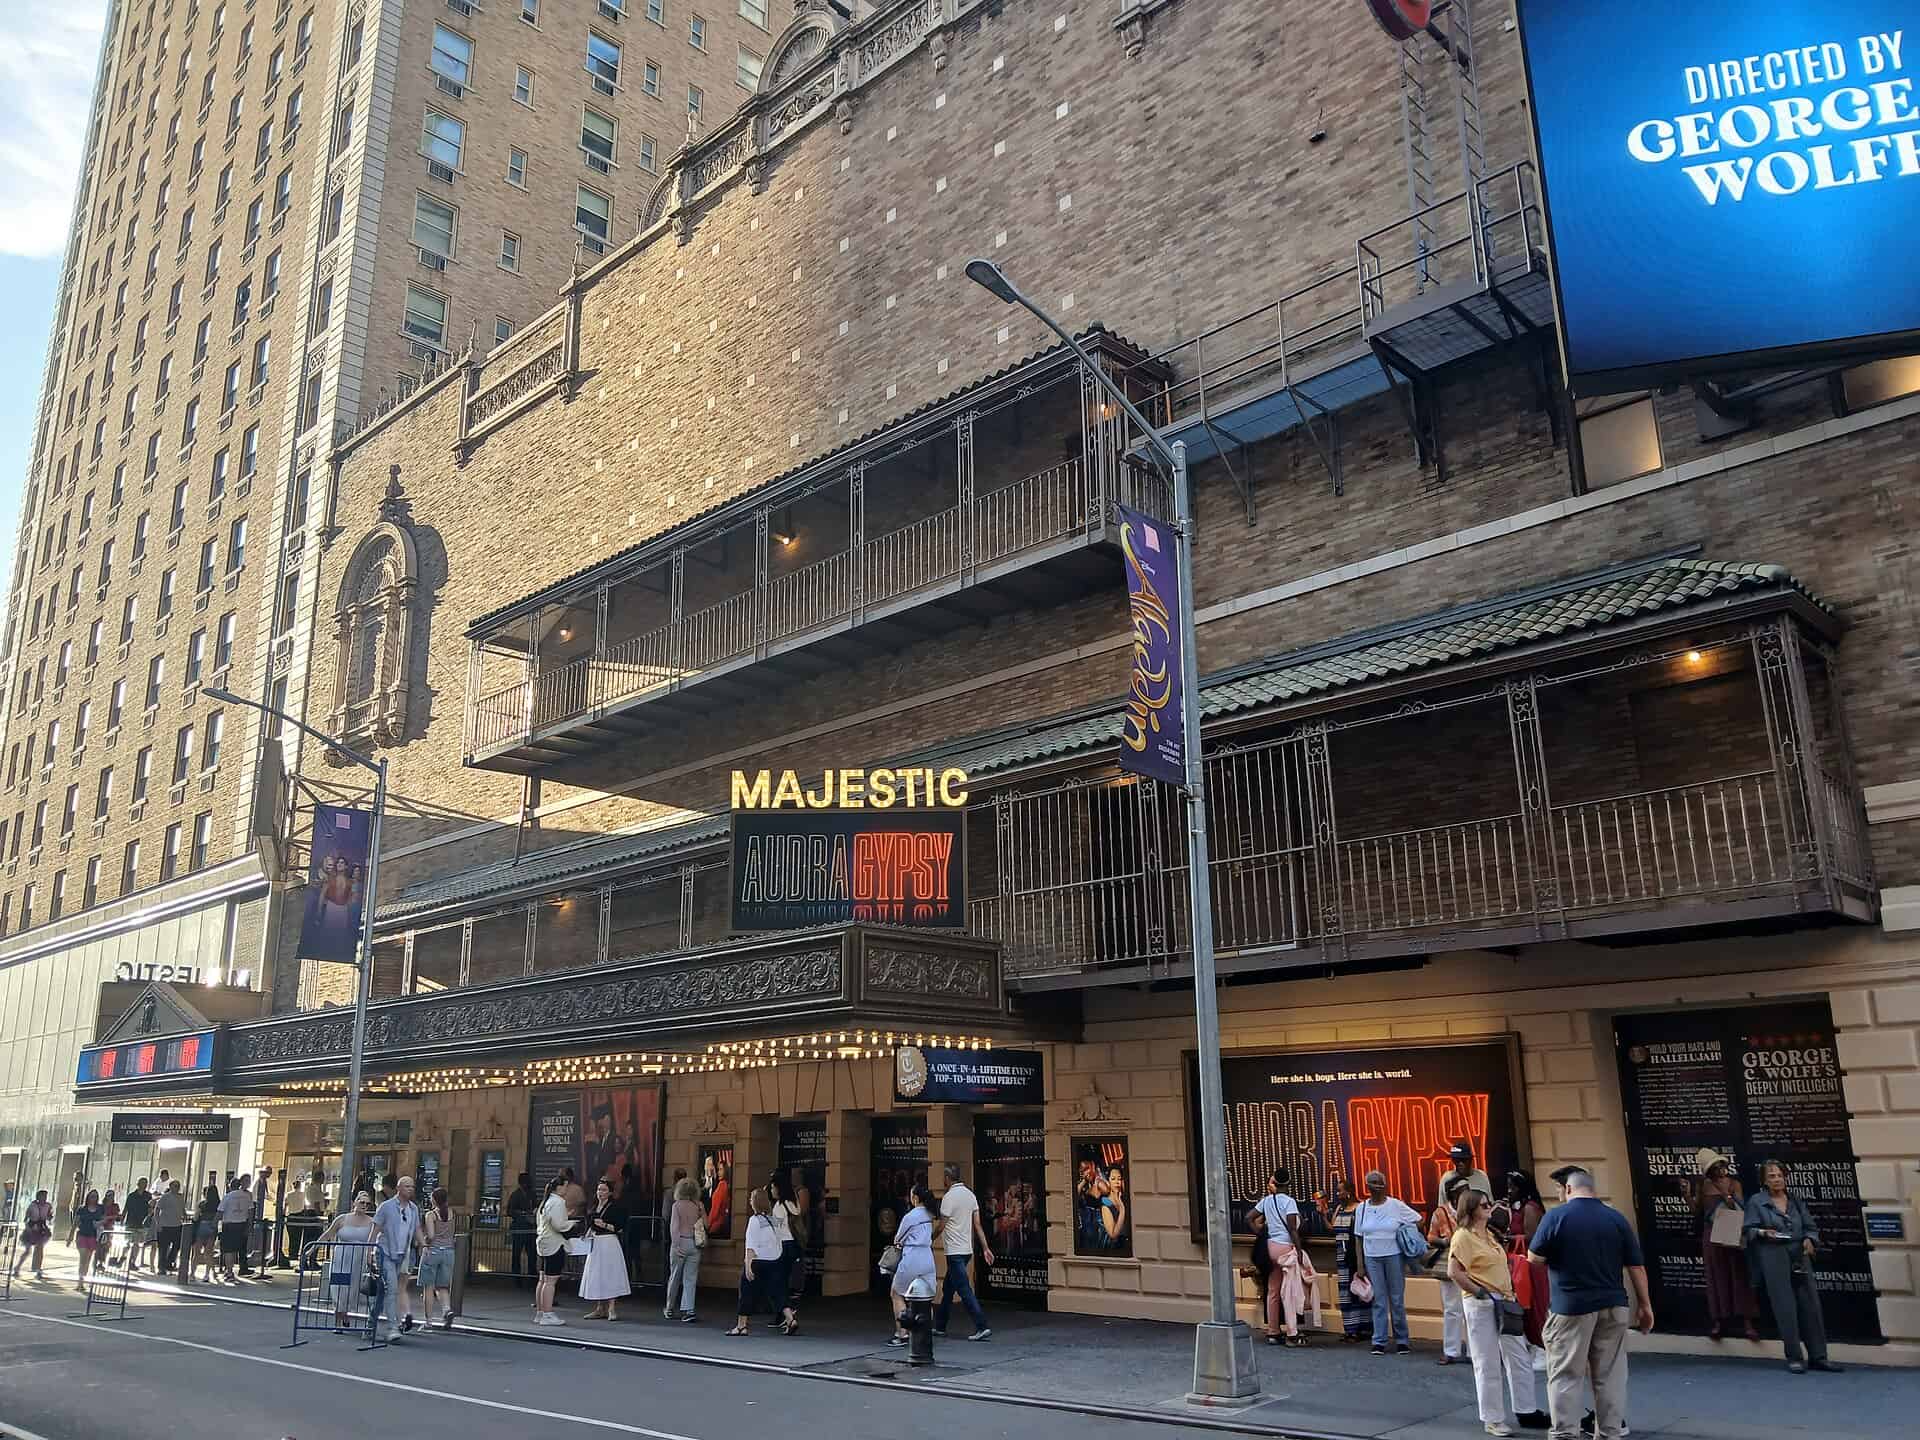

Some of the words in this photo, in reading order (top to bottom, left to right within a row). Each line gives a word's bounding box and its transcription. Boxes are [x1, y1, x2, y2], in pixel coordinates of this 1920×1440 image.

[1684, 42, 1847, 104] DIRECTED
[1858, 30, 1904, 75] BY
[1627, 78, 1920, 163] GEORGE
[730, 767, 969, 808] MAJESTIC
[742, 834, 849, 903] AUDRA
[852, 831, 954, 900] GYPSY
[1742, 1047, 1834, 1068] GEORGE
[934, 1074, 997, 1085] TOP-TO-BOTTOM
[1271, 1074, 1289, 1084] Here
[1290, 1074, 1304, 1082] she
[1338, 1072, 1357, 1080] Here
[1358, 1071, 1372, 1079] she
[1743, 1068, 1760, 1080] C.
[1764, 1064, 1836, 1079] WOLFE'S
[1746, 1080, 1779, 1095] DEEPLY
[1781, 1078, 1839, 1093] INTELLIGENT
[1348, 1093, 1489, 1204] GYPSY
[1648, 1154, 1674, 1164] YOU
[1793, 1162, 1851, 1171] McDONALD
[1816, 1172, 1828, 1186] IN
[1831, 1171, 1854, 1186] THIS
[1820, 1186, 1857, 1199] REVIVAL
